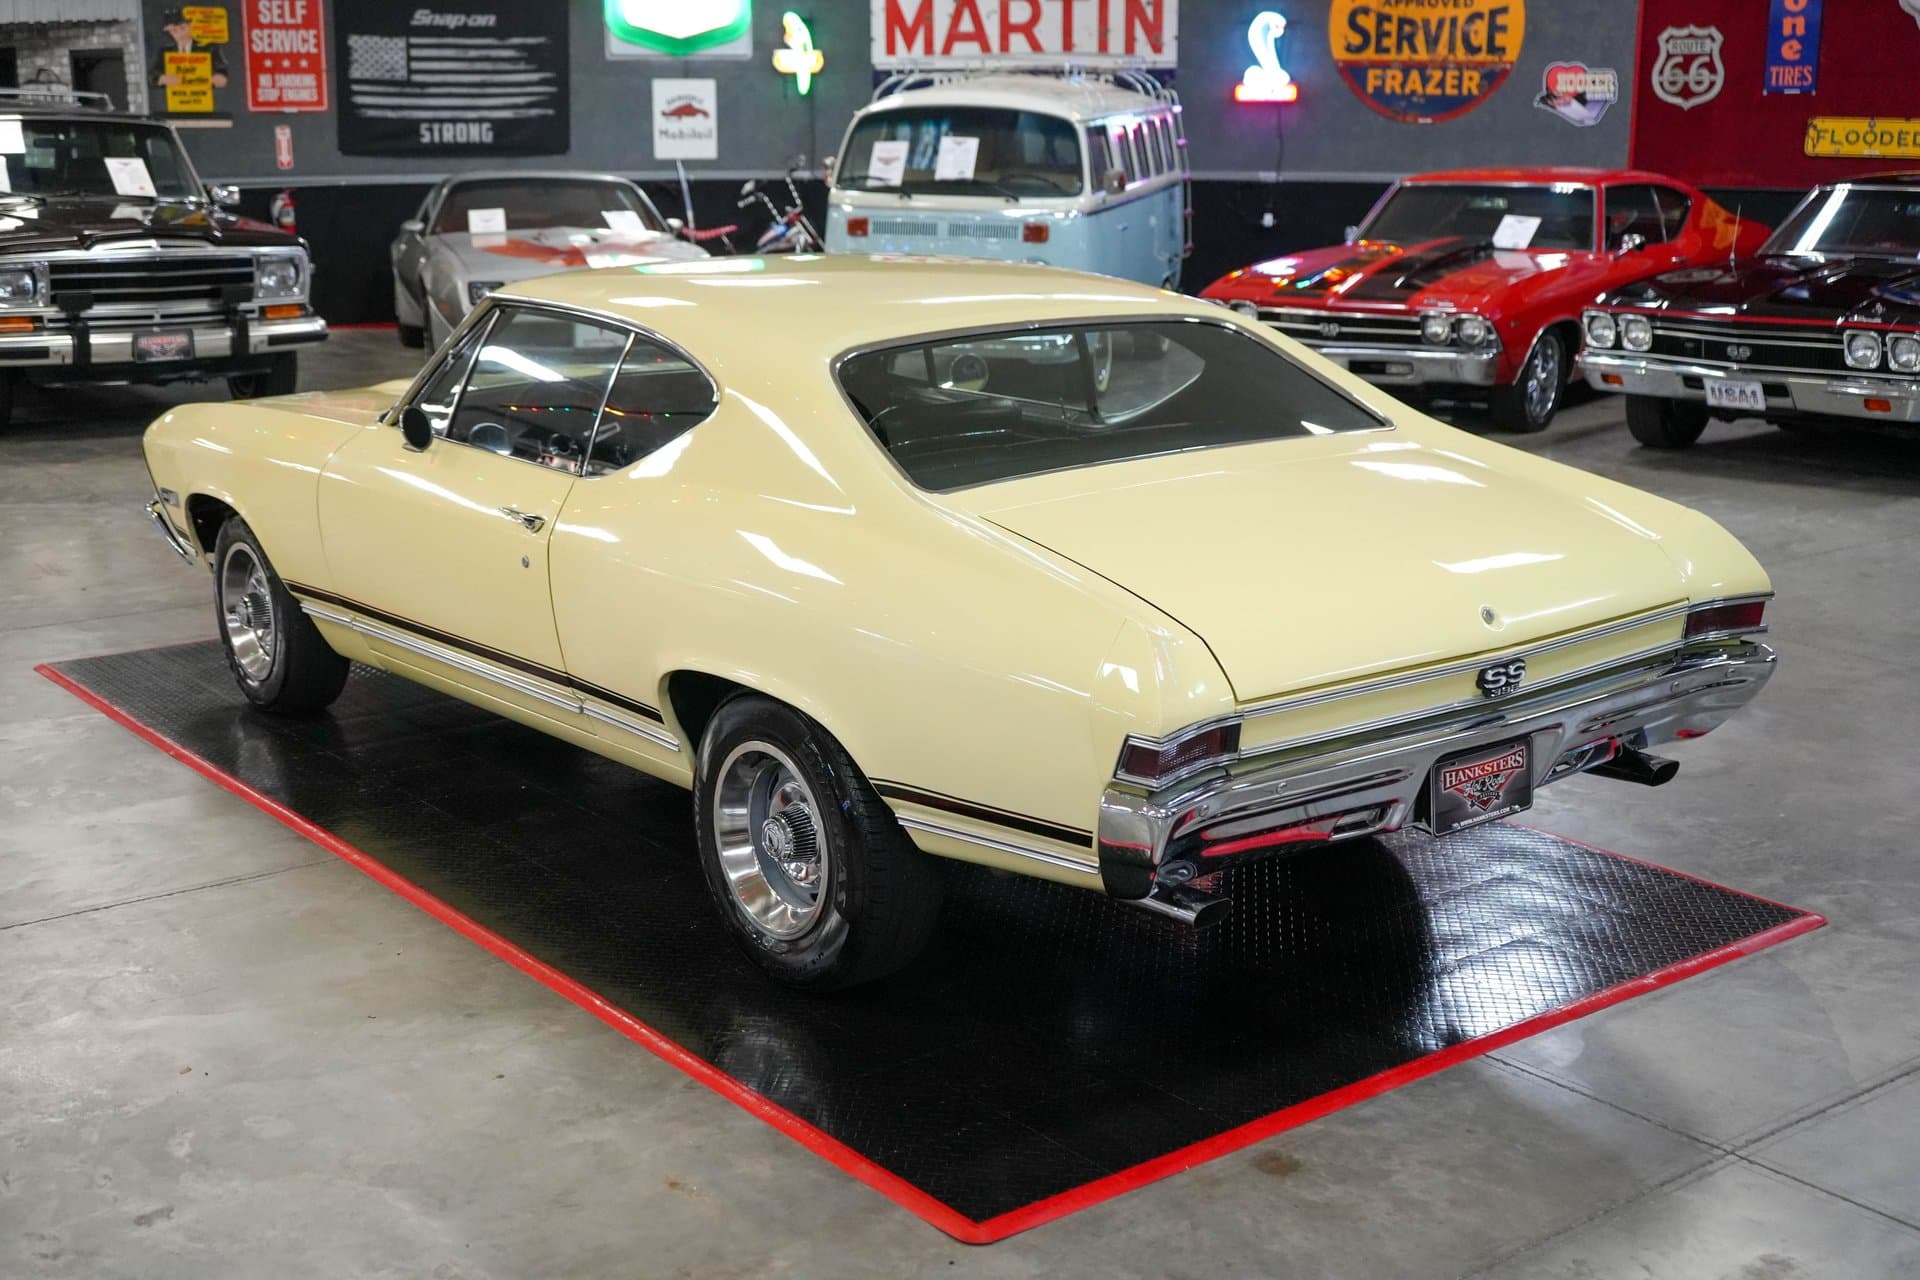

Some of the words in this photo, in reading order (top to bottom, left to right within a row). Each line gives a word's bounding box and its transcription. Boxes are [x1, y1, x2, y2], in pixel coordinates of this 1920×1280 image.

[258, 0, 307, 24] SELF
[410, 9, 497, 29] Snap-on
[884, 0, 1164, 56] MARTIN
[1344, 6, 1510, 57] SERVICE
[251, 29, 319, 54] SERVICE
[1671, 40, 1707, 52] ROUTE
[1366, 68, 1482, 96] FRAZER
[1556, 72, 1616, 93] HOOKER
[1662, 55, 1711, 94] 66
[1769, 65, 1813, 86] TIRES
[419, 123, 493, 144] STRONG
[1484, 662, 1525, 689] SS
[1445, 751, 1524, 789] HANKSTERS
